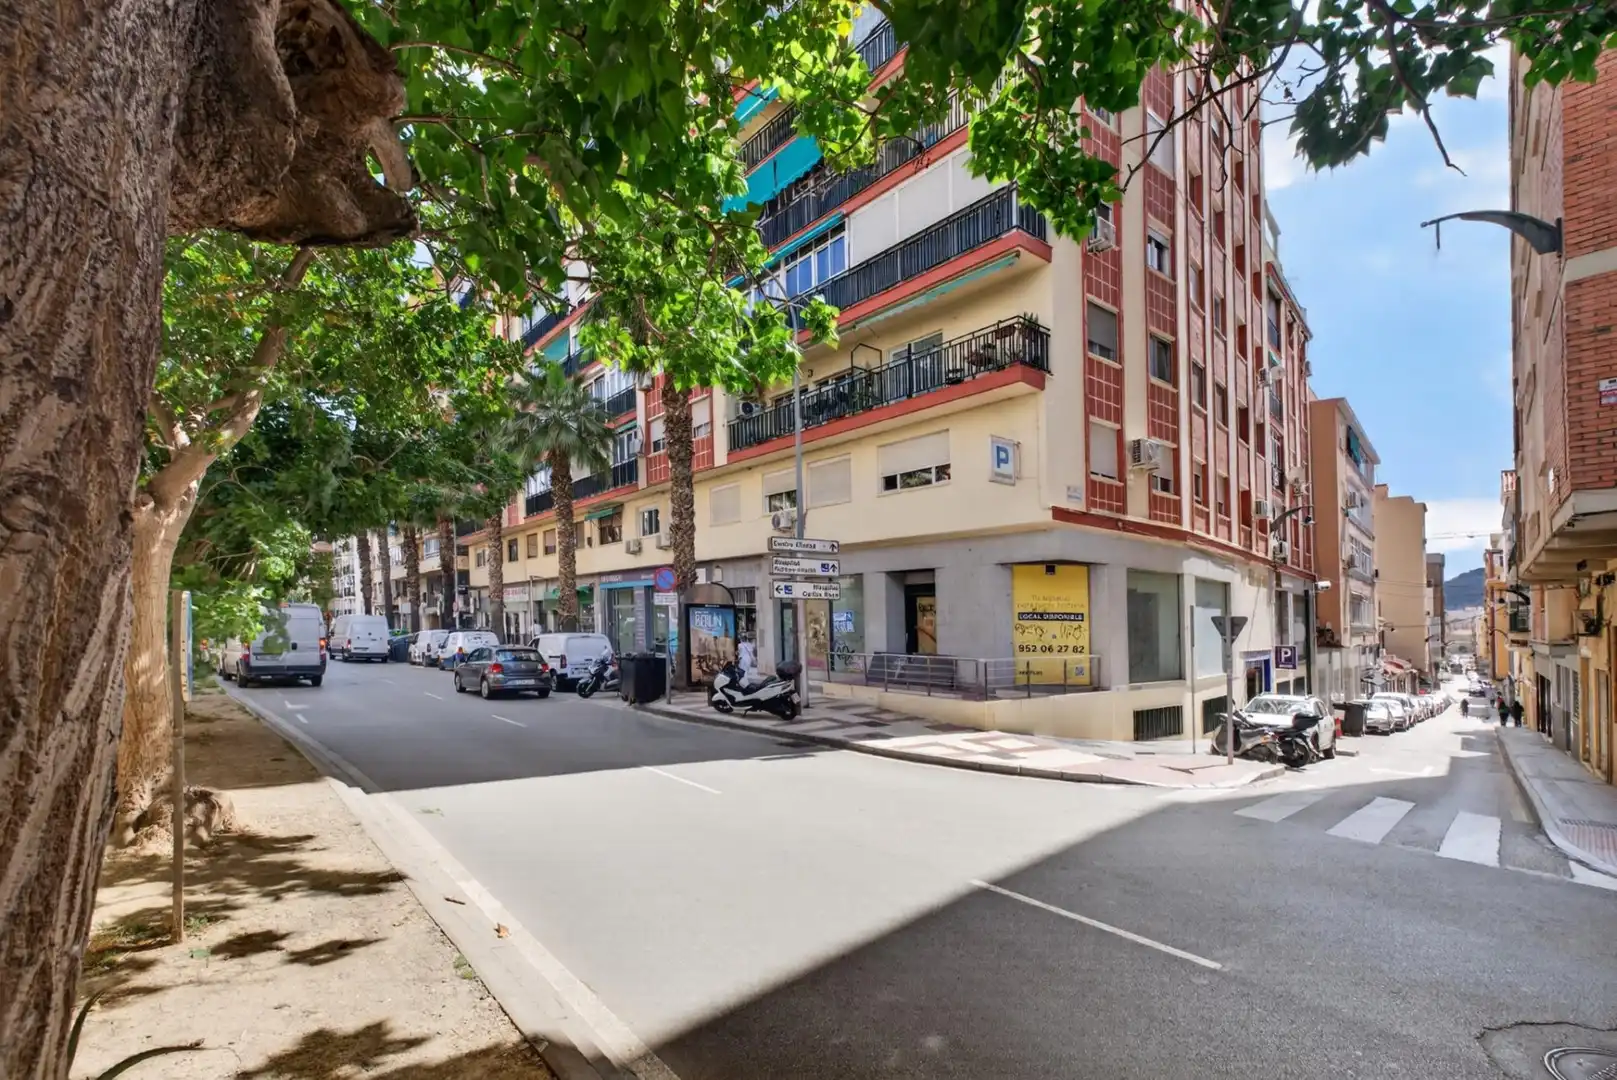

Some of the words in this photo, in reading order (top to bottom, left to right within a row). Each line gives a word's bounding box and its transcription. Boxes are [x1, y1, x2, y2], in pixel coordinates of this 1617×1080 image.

[996, 446, 1009, 469] P
[694, 613, 722, 628] BERLIN
[1040, 644, 1054, 653] 06
[1057, 645, 1070, 653] 27
[1281, 648, 1291, 663] P
